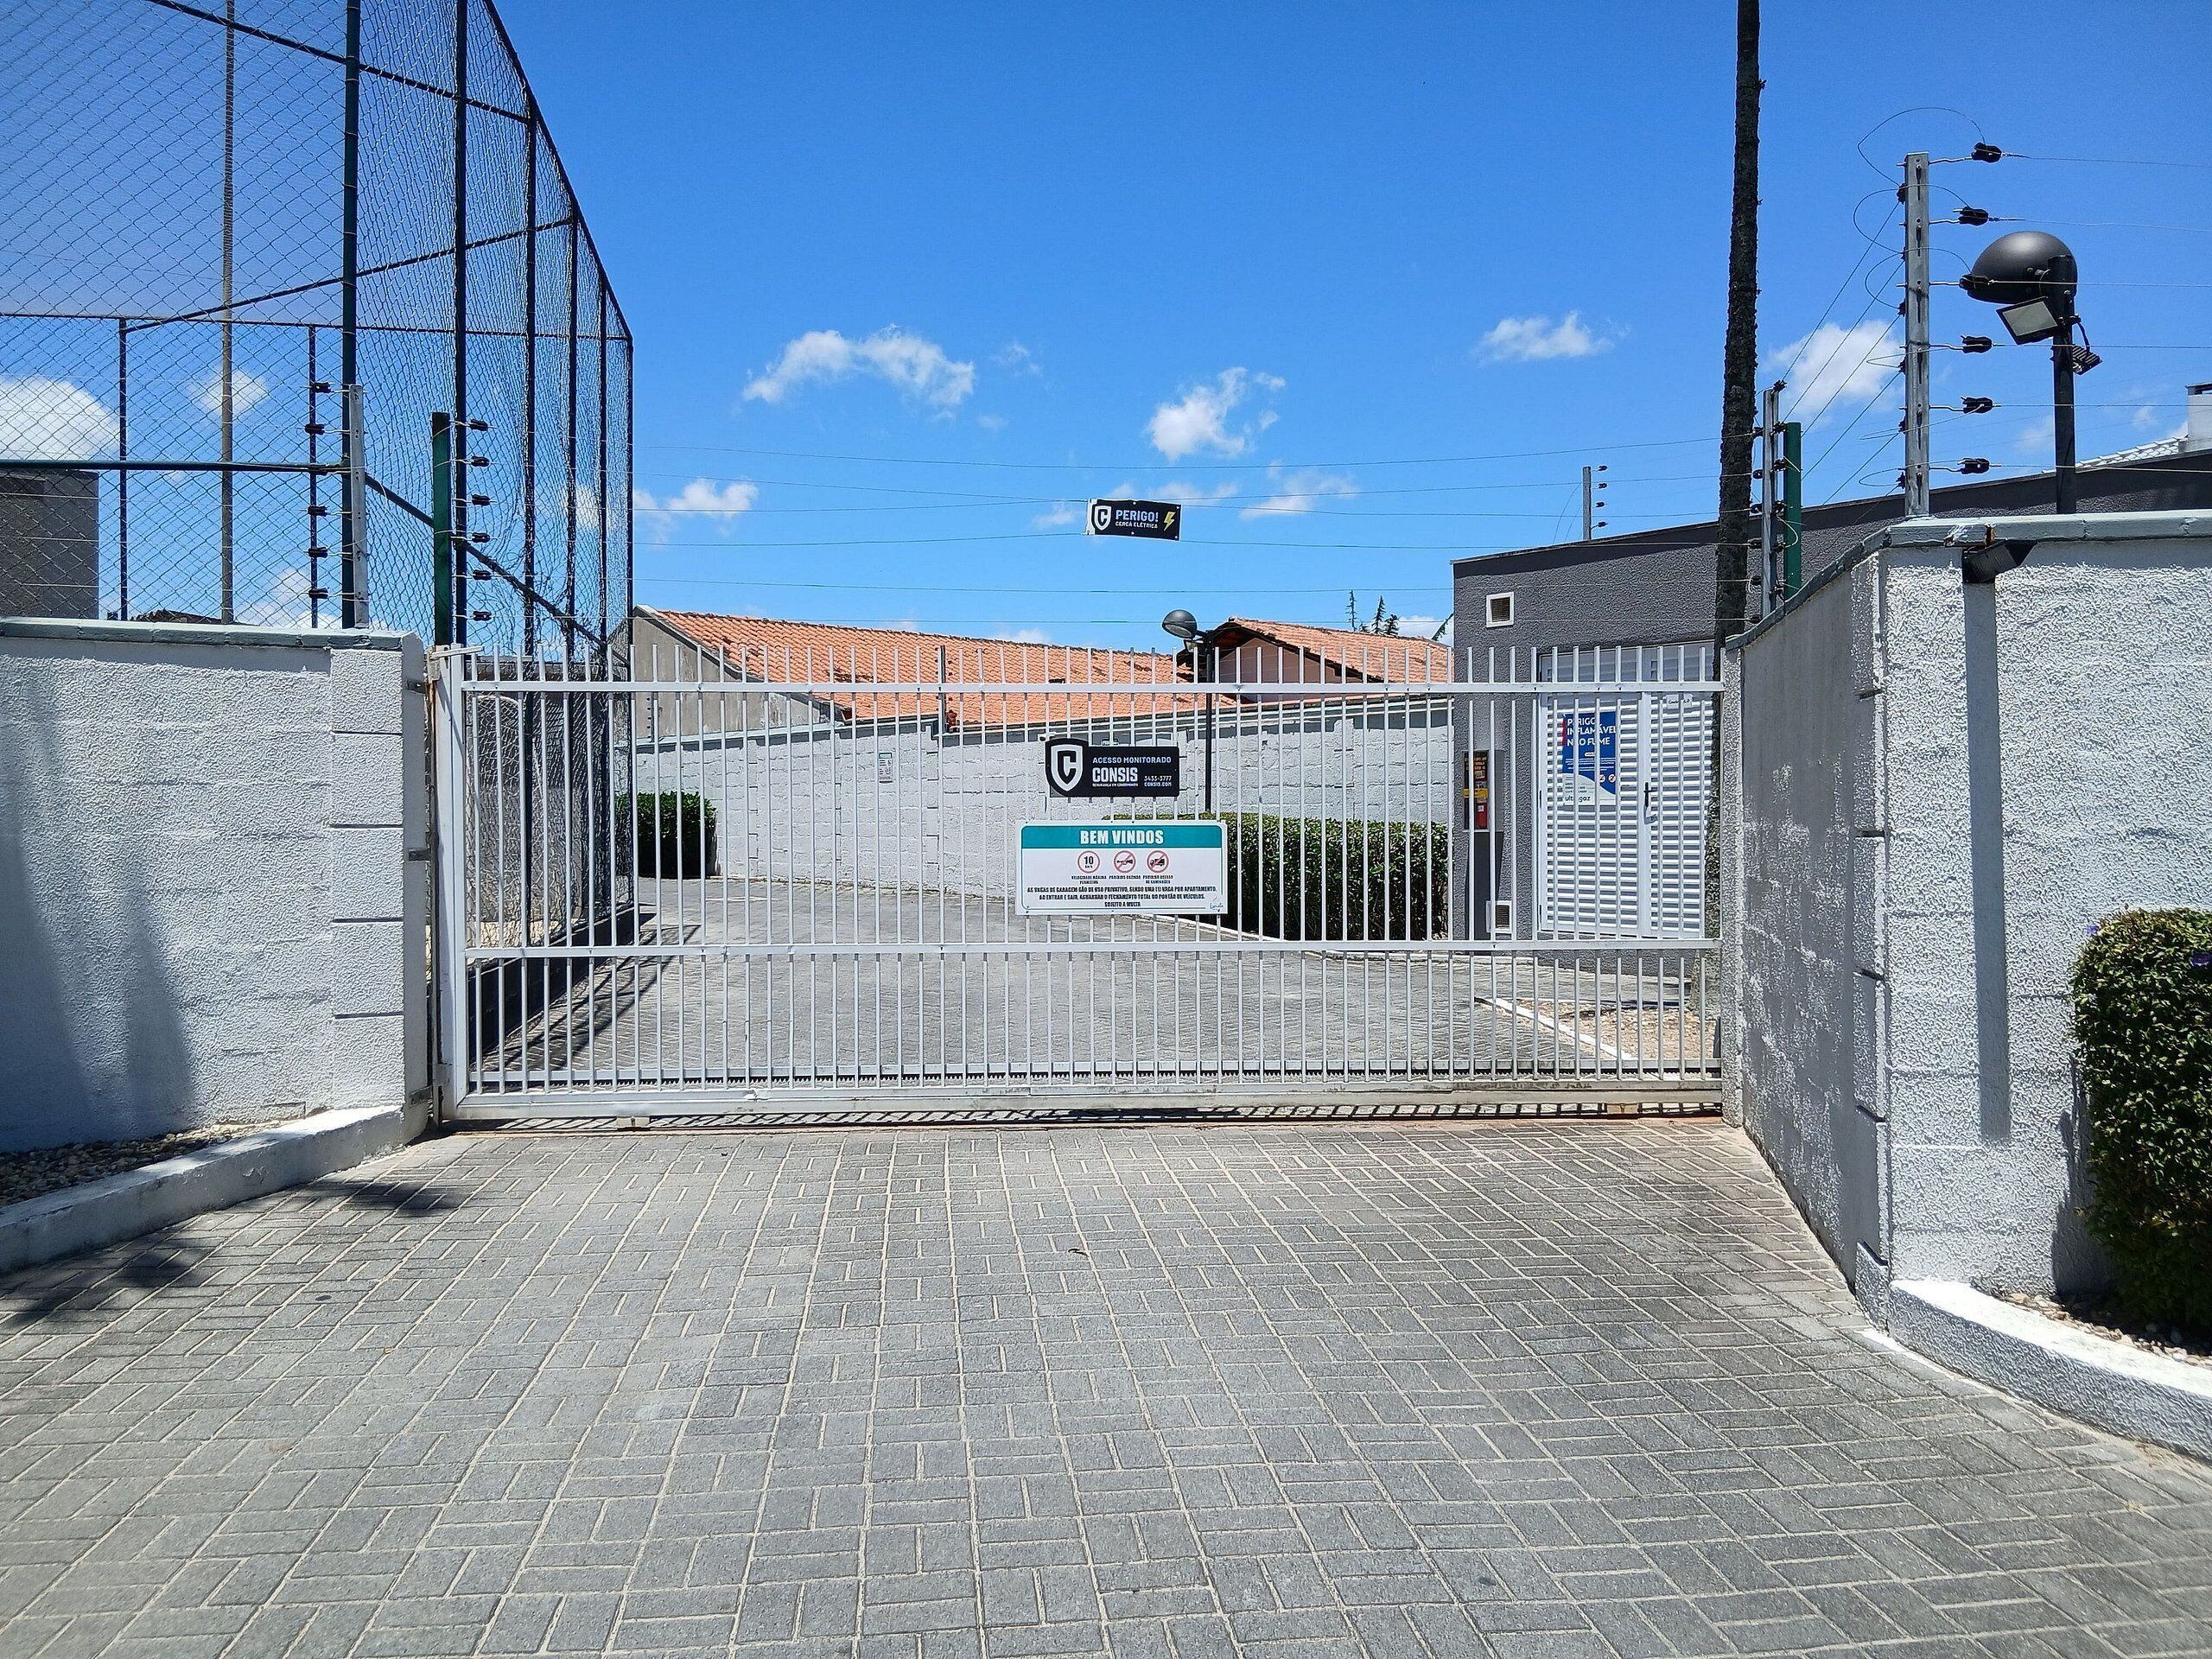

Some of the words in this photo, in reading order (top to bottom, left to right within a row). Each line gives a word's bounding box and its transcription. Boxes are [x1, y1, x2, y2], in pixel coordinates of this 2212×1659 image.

[1116, 510, 1159, 522] PERIGO!
[1567, 717, 1597, 726] PRIGO
[1092, 767, 1138, 782] CONSIS
[1080, 830, 1109, 844] BEM
[1112, 830, 1164, 844] VINDOS
